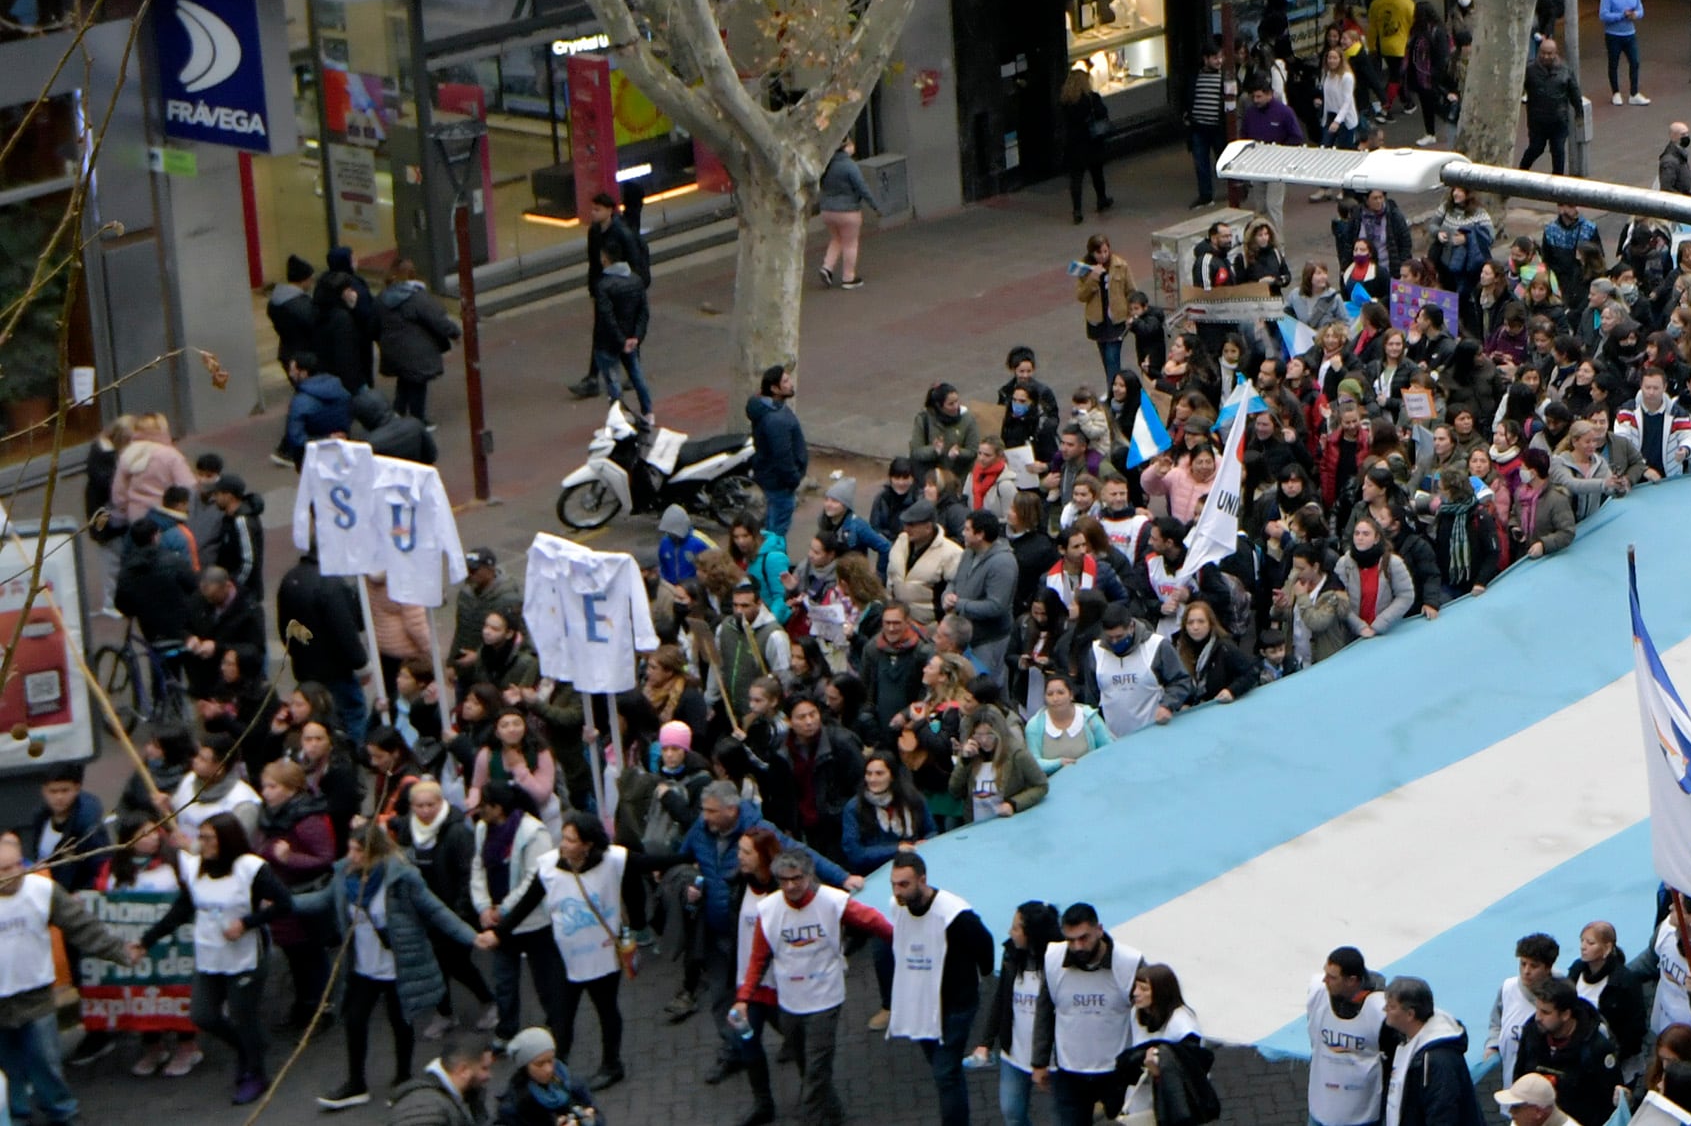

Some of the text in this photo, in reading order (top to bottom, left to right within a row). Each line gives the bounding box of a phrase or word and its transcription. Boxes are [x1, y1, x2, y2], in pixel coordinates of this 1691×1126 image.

[166, 96, 267, 137] FRÁVEGA
[583, 592, 609, 643] E
[1112, 673, 1138, 686] SUTE
[781, 923, 826, 944] SUTE
[1073, 993, 1106, 1007] SUTE
[1321, 1028, 1366, 1051] SUTE
